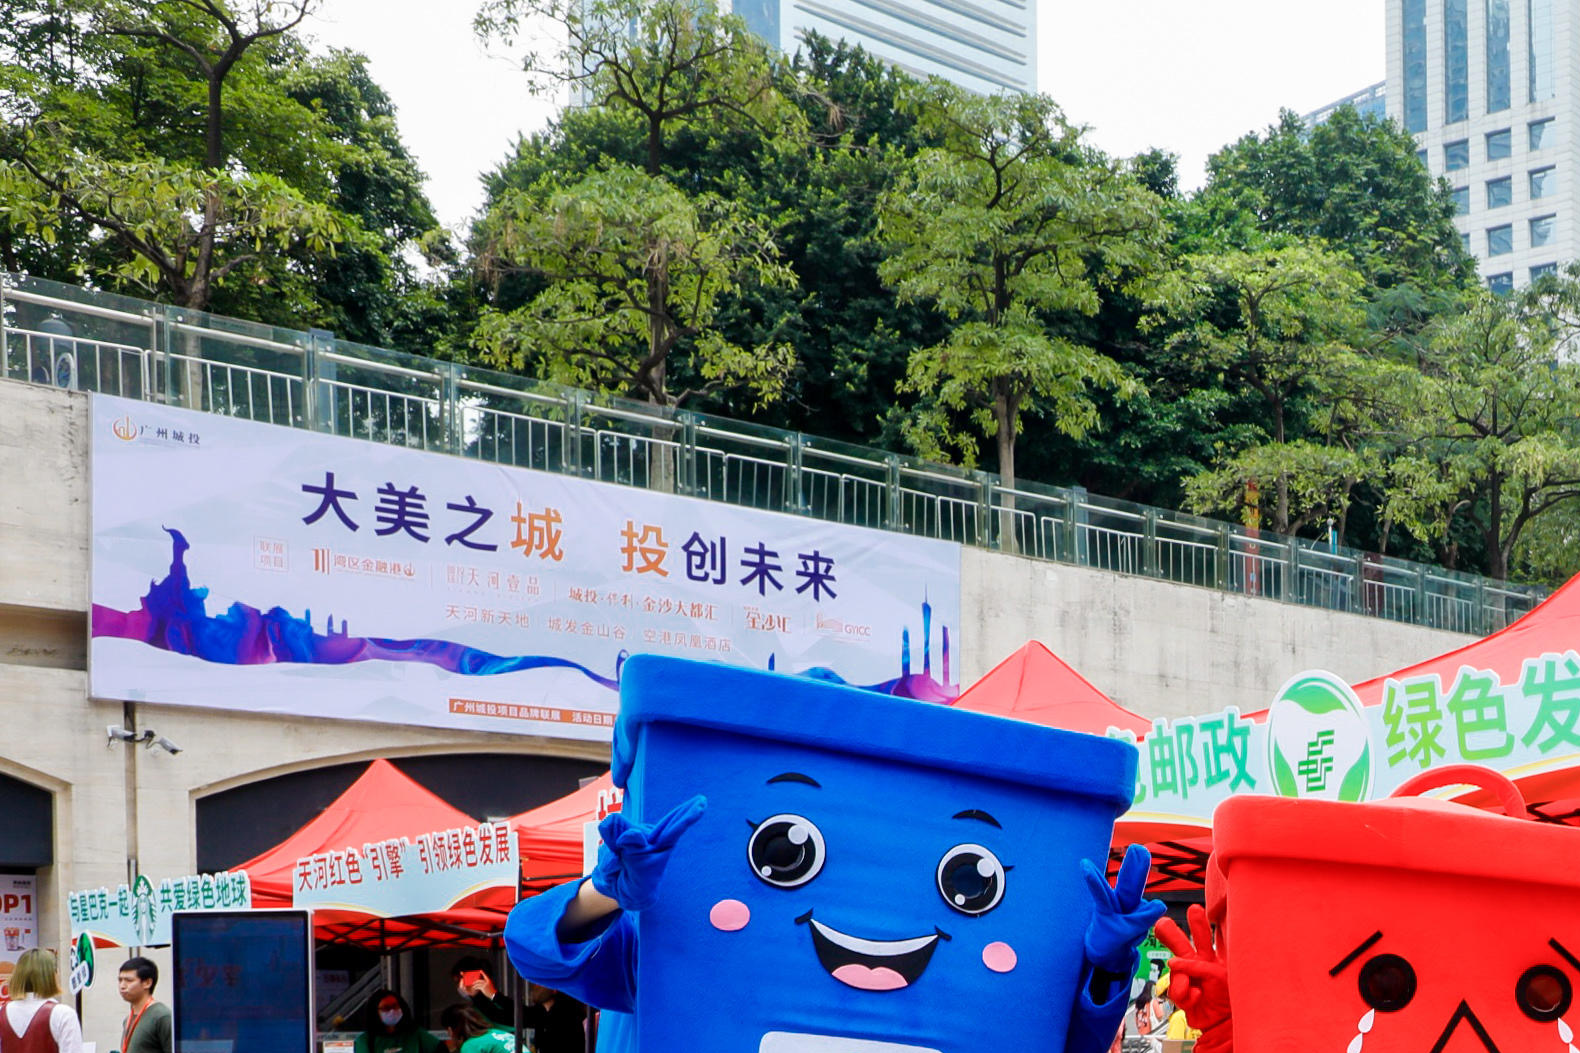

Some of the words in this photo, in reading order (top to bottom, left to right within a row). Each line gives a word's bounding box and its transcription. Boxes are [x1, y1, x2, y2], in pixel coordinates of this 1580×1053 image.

[140, 425, 200, 446] 广州城投
[302, 472, 564, 562] 大美之城
[620, 520, 837, 602] 投创未来
[333, 554, 402, 575] 湾区金融港
[446, 604, 530, 628] 天河新天地
[548, 616, 626, 641] 城发金山谷
[643, 629, 732, 652] 空港凤凰酒店
[453, 701, 561, 722] 广州城投项目品牌联展
[572, 712, 614, 726] 活动日期
[417, 826, 511, 875] 引领绿色发展
[0, 893, 31, 914] P1
[70, 889, 129, 923] 与星巴克一起
[160, 873, 247, 913] 共爱绿色地球
